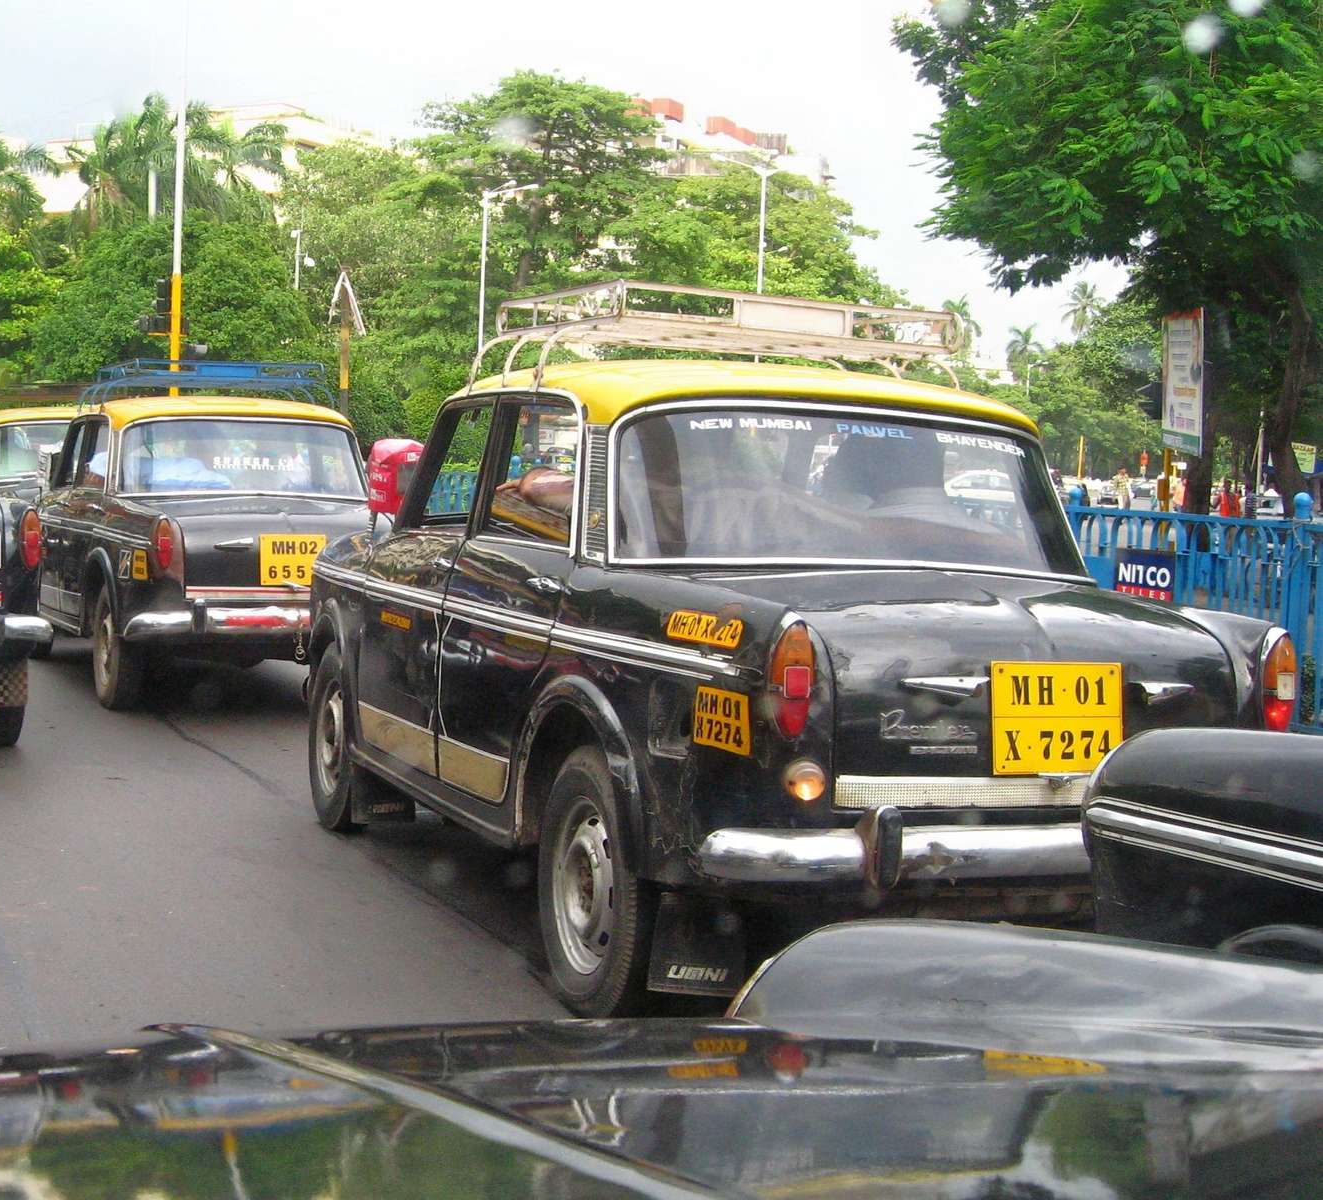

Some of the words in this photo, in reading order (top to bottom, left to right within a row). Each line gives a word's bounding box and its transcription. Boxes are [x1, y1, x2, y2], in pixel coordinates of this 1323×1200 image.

[690, 419, 732, 430] NEW
[740, 418, 812, 431] MUMBAI
[836, 423, 913, 440] PANVEL
[936, 432, 1026, 458] BHAYENDER
[1118, 563, 1171, 588] NITCO
[1122, 586, 1166, 600] TILES
